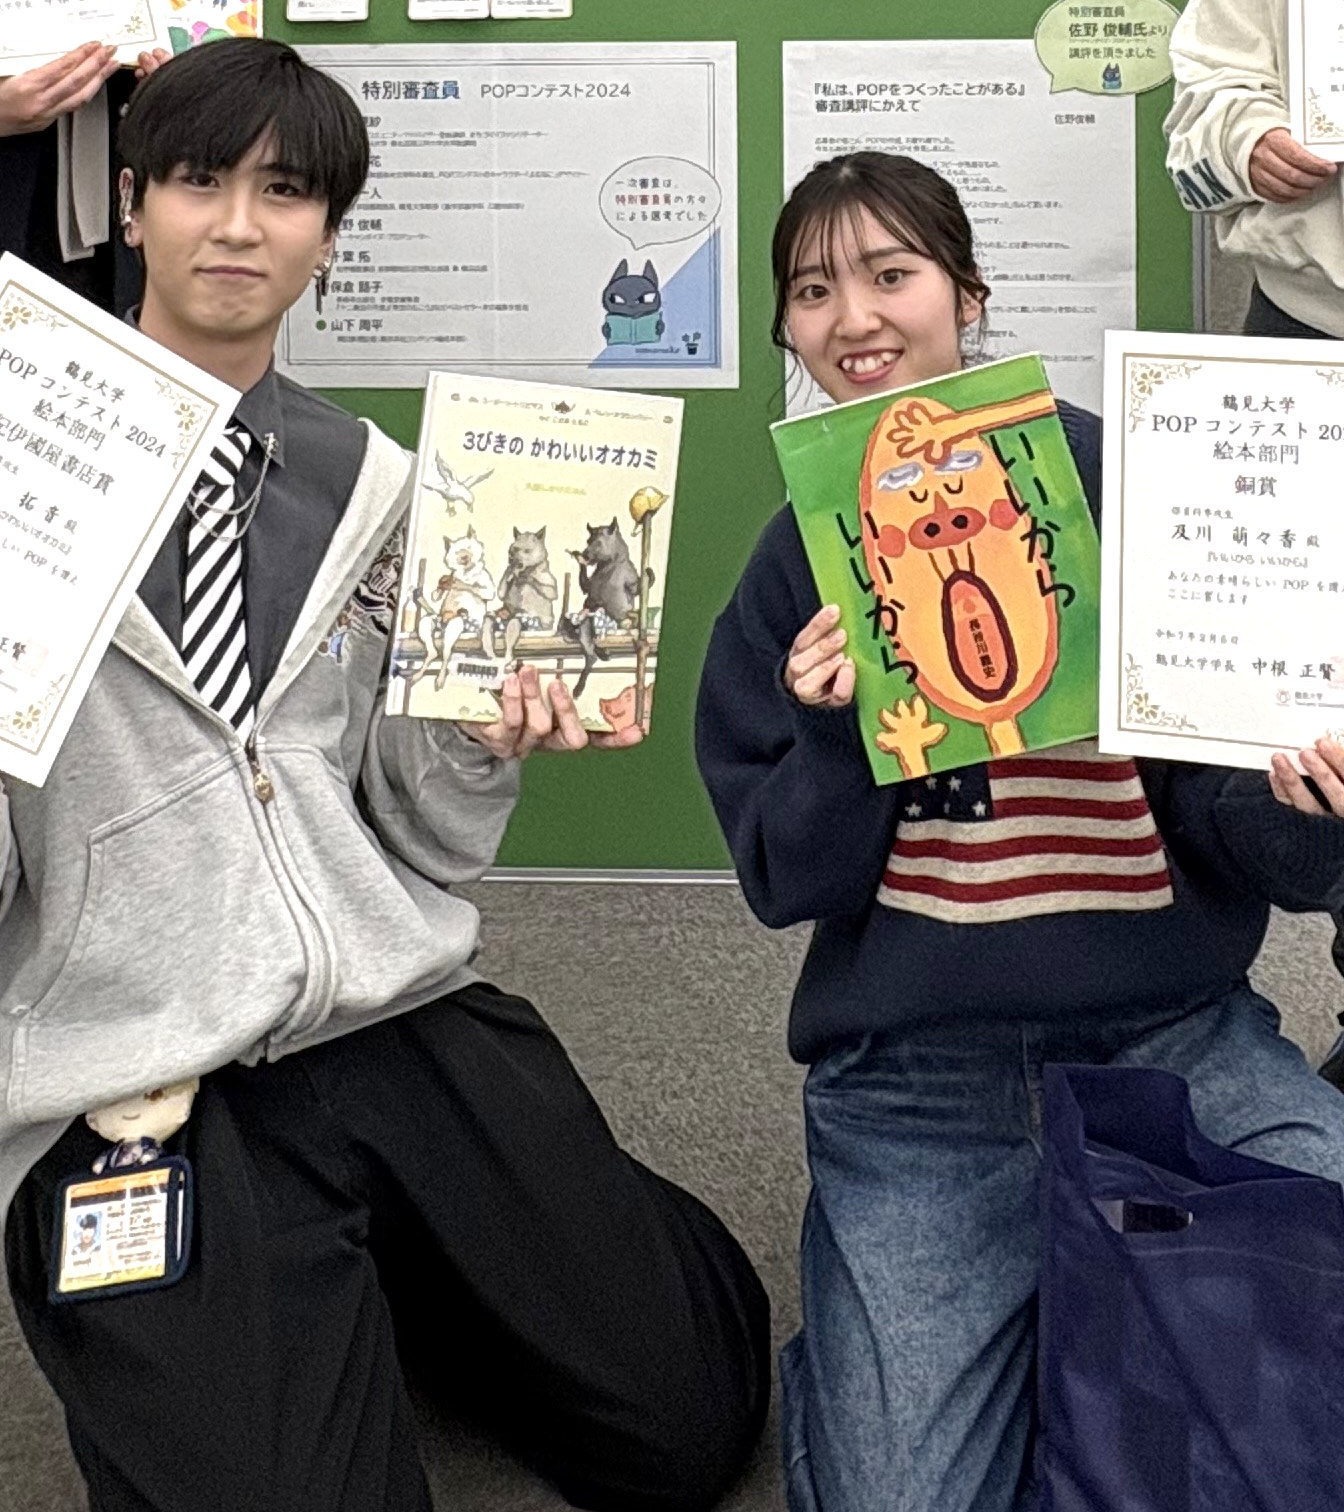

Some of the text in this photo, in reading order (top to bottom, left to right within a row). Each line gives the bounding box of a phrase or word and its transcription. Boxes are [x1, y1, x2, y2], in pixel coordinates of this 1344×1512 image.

[1068, 23, 1099, 38] 佐野
[362, 80, 632, 101] 特別審査員 POPコンテスト2024
[814, 82, 1025, 98] 『私は、POPをつくったことがある』
[815, 99, 921, 114] 審査講評にかえて
[330, 319, 355, 332] 山下
[1222, 394, 1296, 415] 鶴見大学
[32, 398, 107, 452] 絵本部門
[40, 375, 122, 432] コンテスト
[125, 424, 168, 458] 2024
[1151, 414, 1198, 434] POP
[1206, 419, 1308, 440] コンテスト
[462, 430, 659, 471] 3びきの かわいいオオカミ
[1212, 441, 1300, 465] 絵本部門
[1234, 474, 1277, 498] 銅賞
[1171, 524, 1213, 542] 及川
[1251, 657, 1290, 677] 中根
